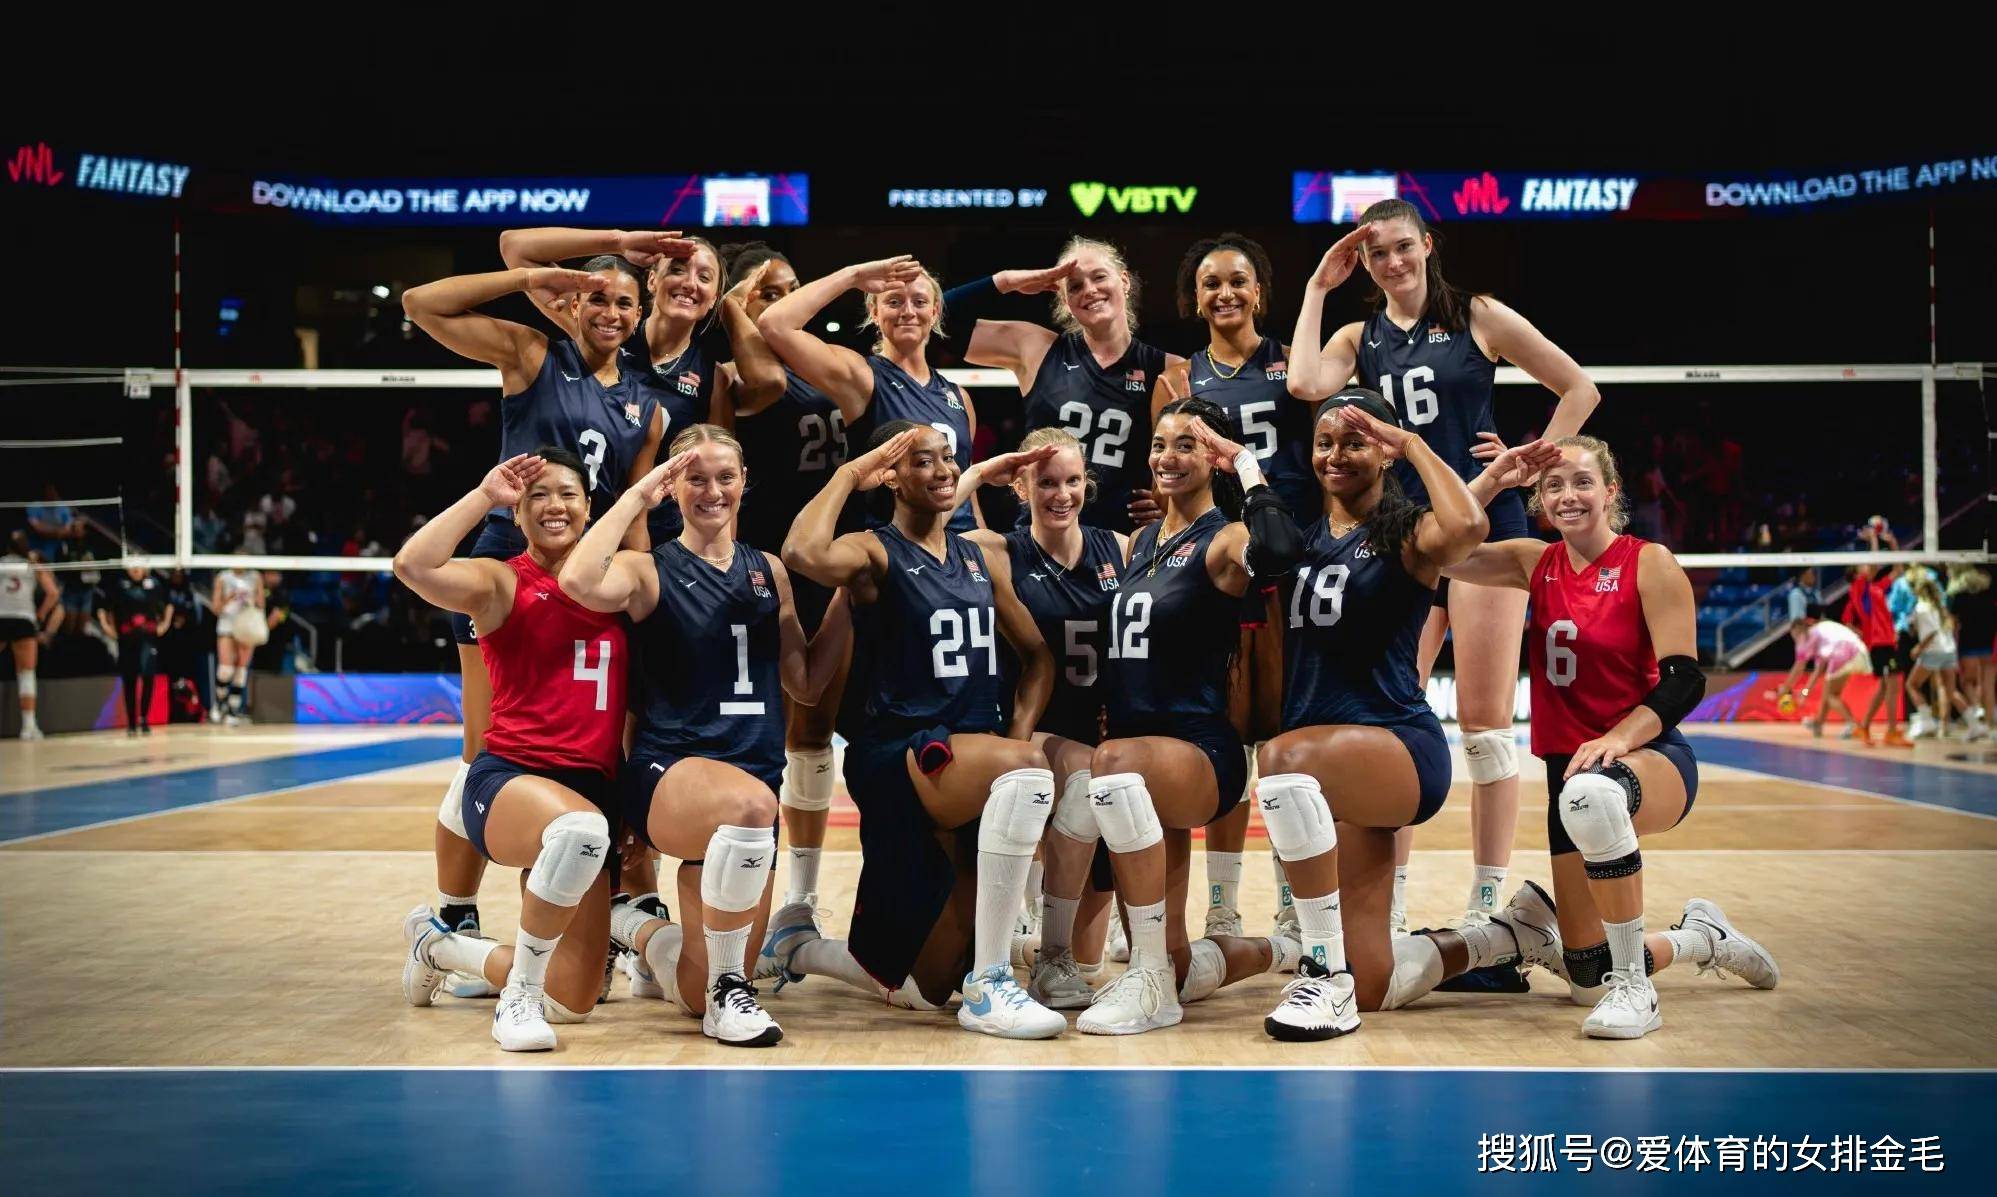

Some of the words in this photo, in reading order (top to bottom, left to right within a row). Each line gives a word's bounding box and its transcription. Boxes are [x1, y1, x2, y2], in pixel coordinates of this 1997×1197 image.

[76, 153, 190, 198] FANTASY
[1706, 174, 1857, 207] DOWNLOAD
[1860, 166, 1909, 194] THE
[1915, 160, 1966, 188] APP
[252, 180, 403, 213] DOWNLOAD
[406, 188, 459, 212] THE
[463, 188, 517, 212] APP
[519, 188, 590, 212] NOW
[888, 188, 1014, 208] PRESENTED
[1017, 188, 1047, 207] BY
[1106, 186, 1197, 213] VBTV
[1521, 178, 1638, 211] FANTASY
[1428, 332, 1451, 344] USA
[677, 382, 699, 398] USA
[1125, 380, 1146, 393] USA
[1380, 365, 1439, 429] 16
[1059, 400, 1133, 468] 22
[1166, 555, 1188, 568] USA
[1354, 546, 1376, 559] US
[754, 586, 772, 599] USA
[1100, 577, 1120, 592] USA
[1288, 564, 1350, 629] 18
[1595, 580, 1619, 593] USA
[1108, 591, 1153, 659] 12
[930, 606, 997, 679] 24
[1064, 619, 1098, 687] 5
[1545, 619, 1578, 687] 6
[573, 639, 611, 711] 4
[731, 624, 753, 695] 1
